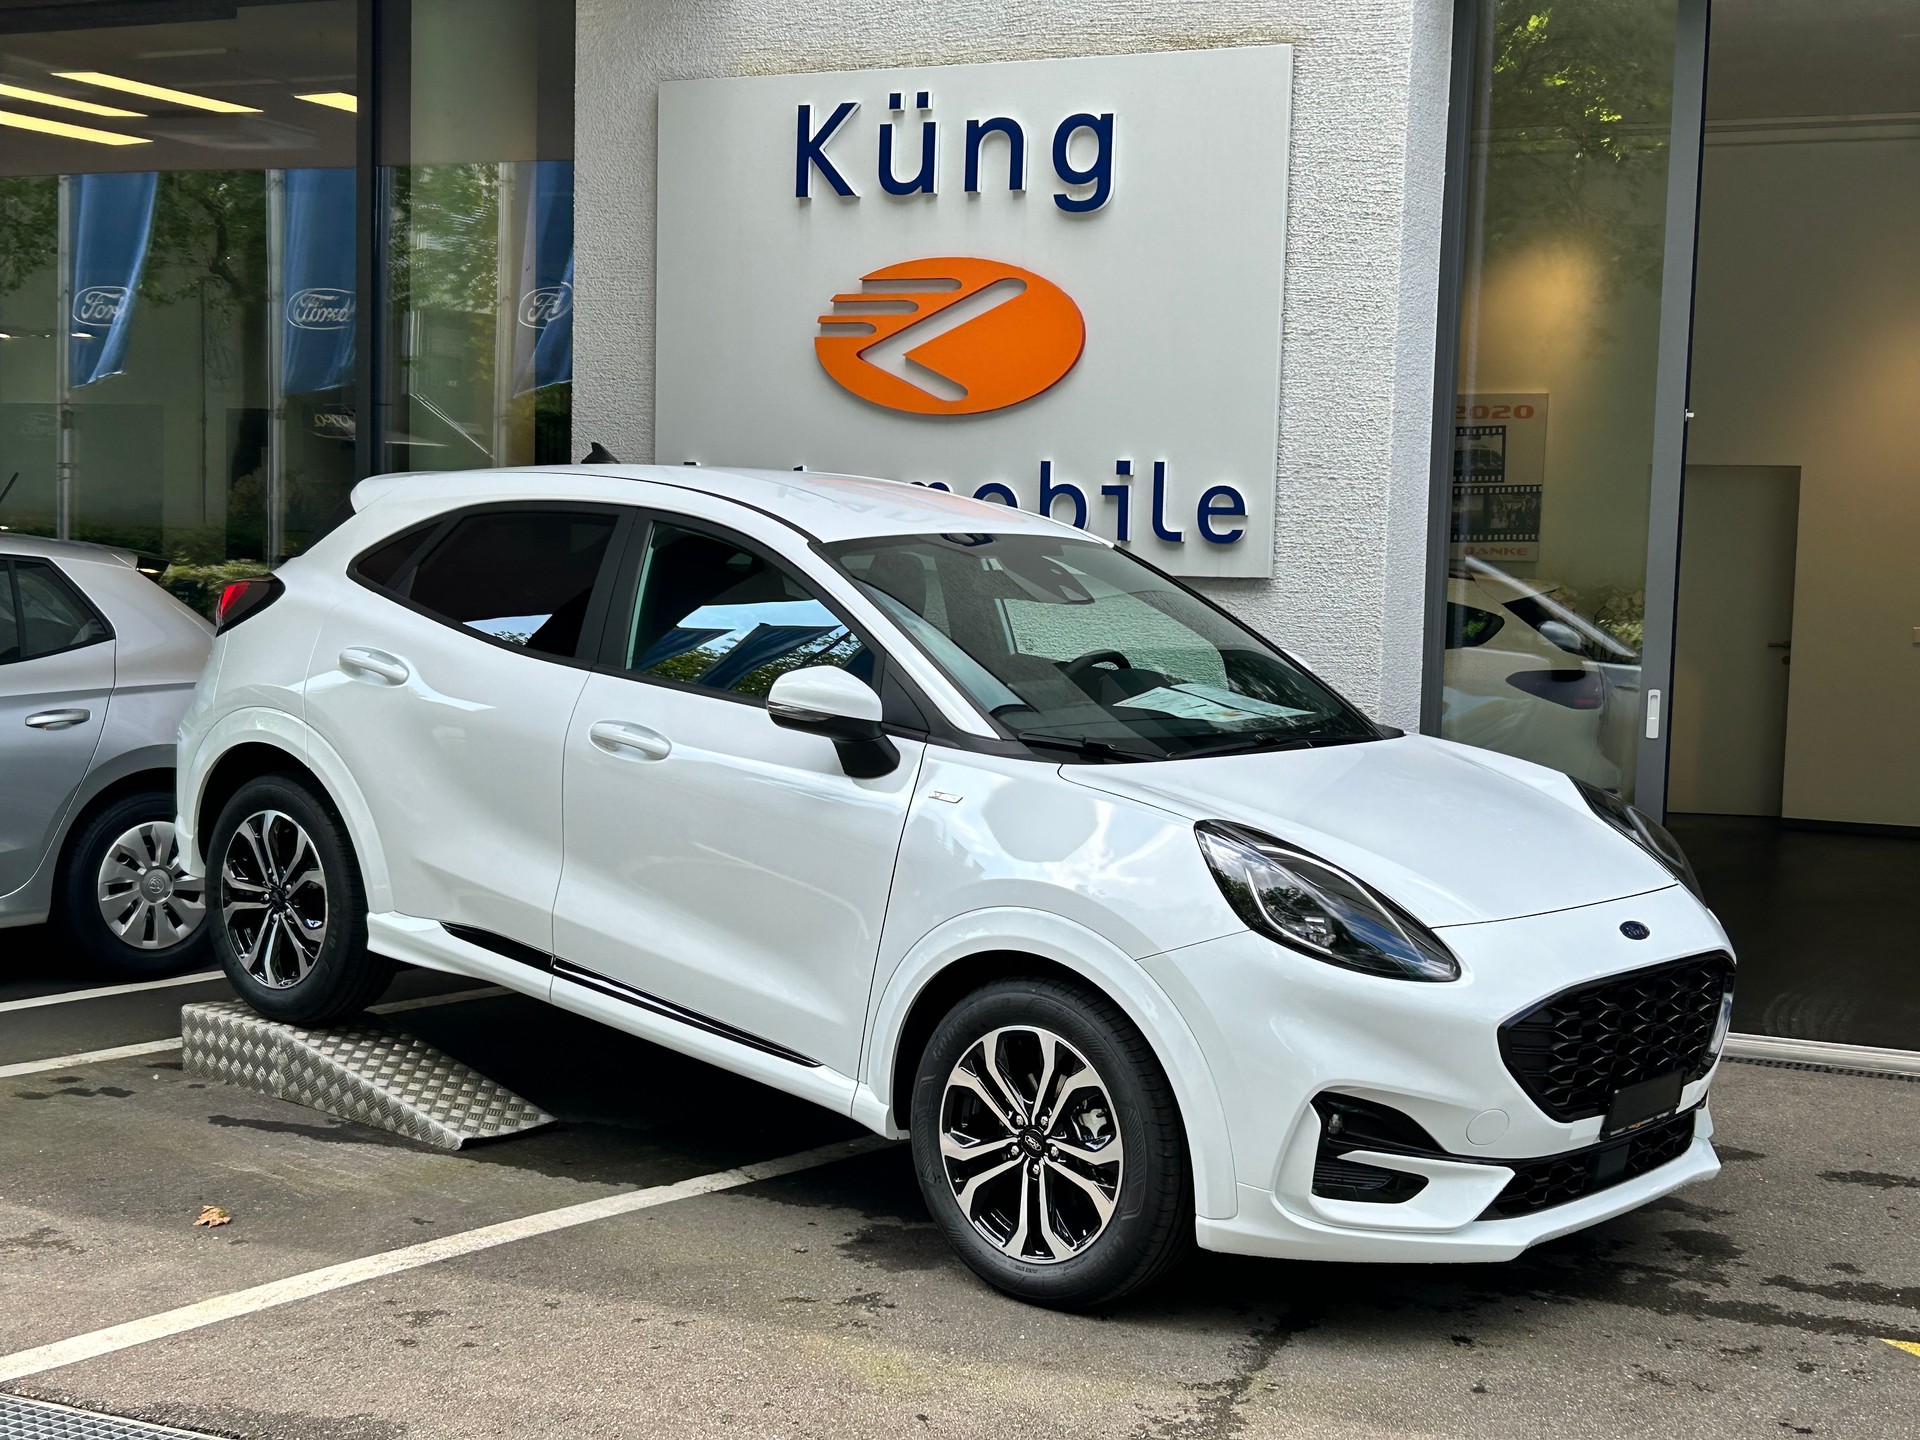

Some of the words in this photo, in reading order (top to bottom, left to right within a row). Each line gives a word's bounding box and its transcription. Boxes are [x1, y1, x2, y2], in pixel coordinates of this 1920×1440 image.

[795, 90, 1115, 213] Küng
[81, 291, 122, 319] For
[1456, 405, 1534, 419] 2020
